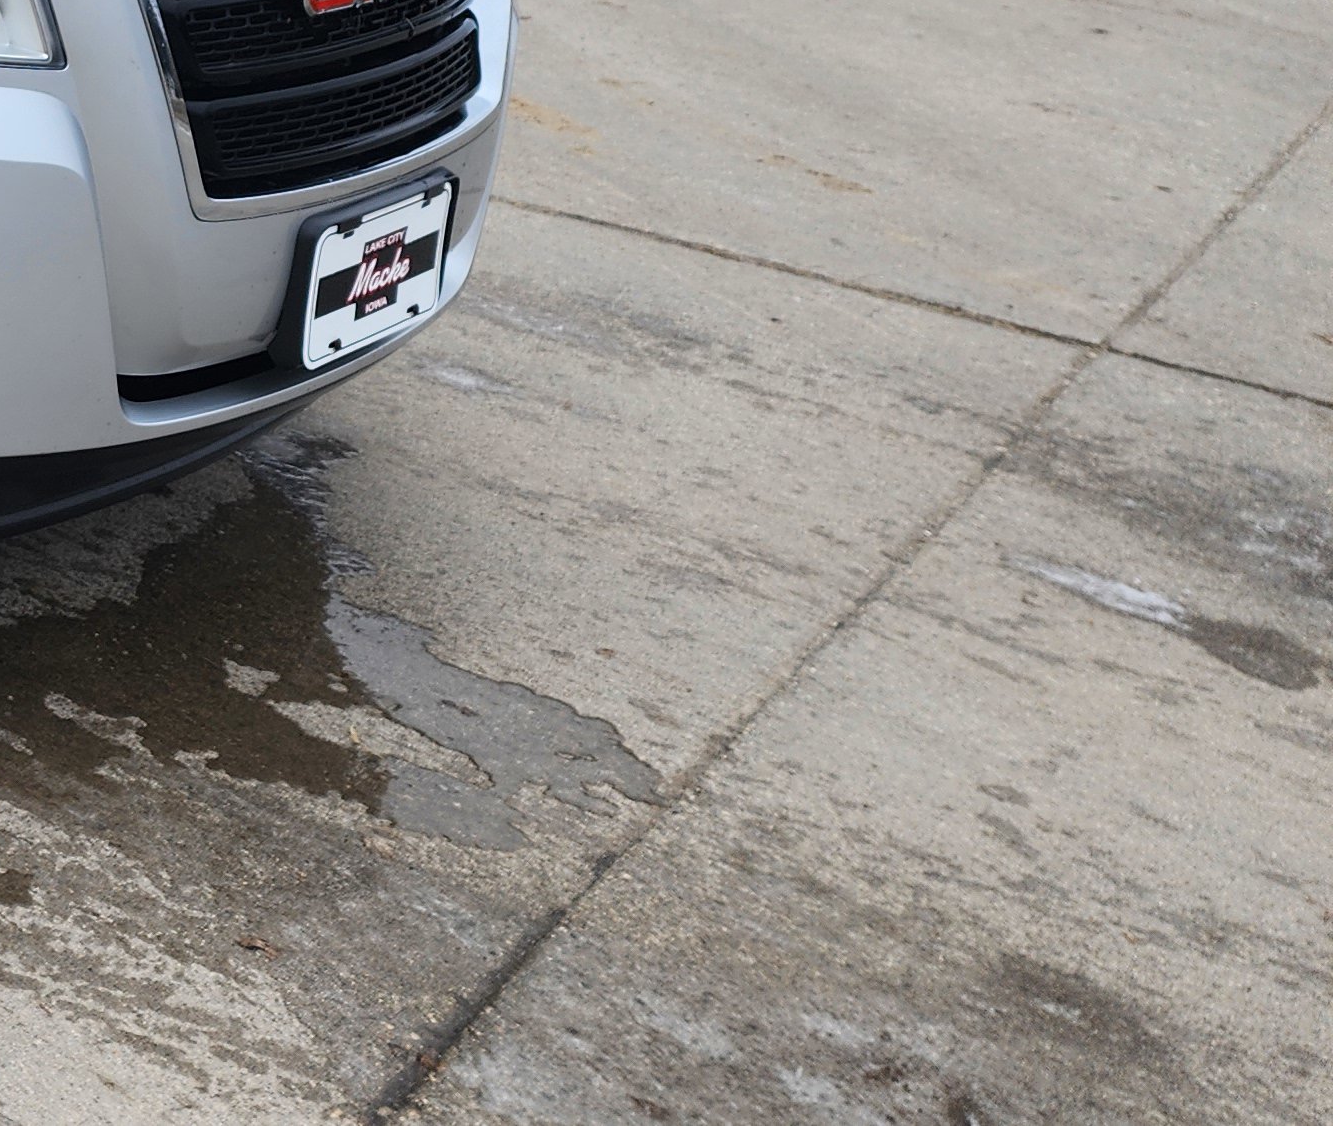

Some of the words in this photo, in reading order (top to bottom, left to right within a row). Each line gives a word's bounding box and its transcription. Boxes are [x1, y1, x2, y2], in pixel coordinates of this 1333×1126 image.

[364, 238, 386, 255] LAKE
[387, 230, 405, 247] CITY
[347, 246, 411, 302] Macke
[364, 296, 388, 314] IOWA
